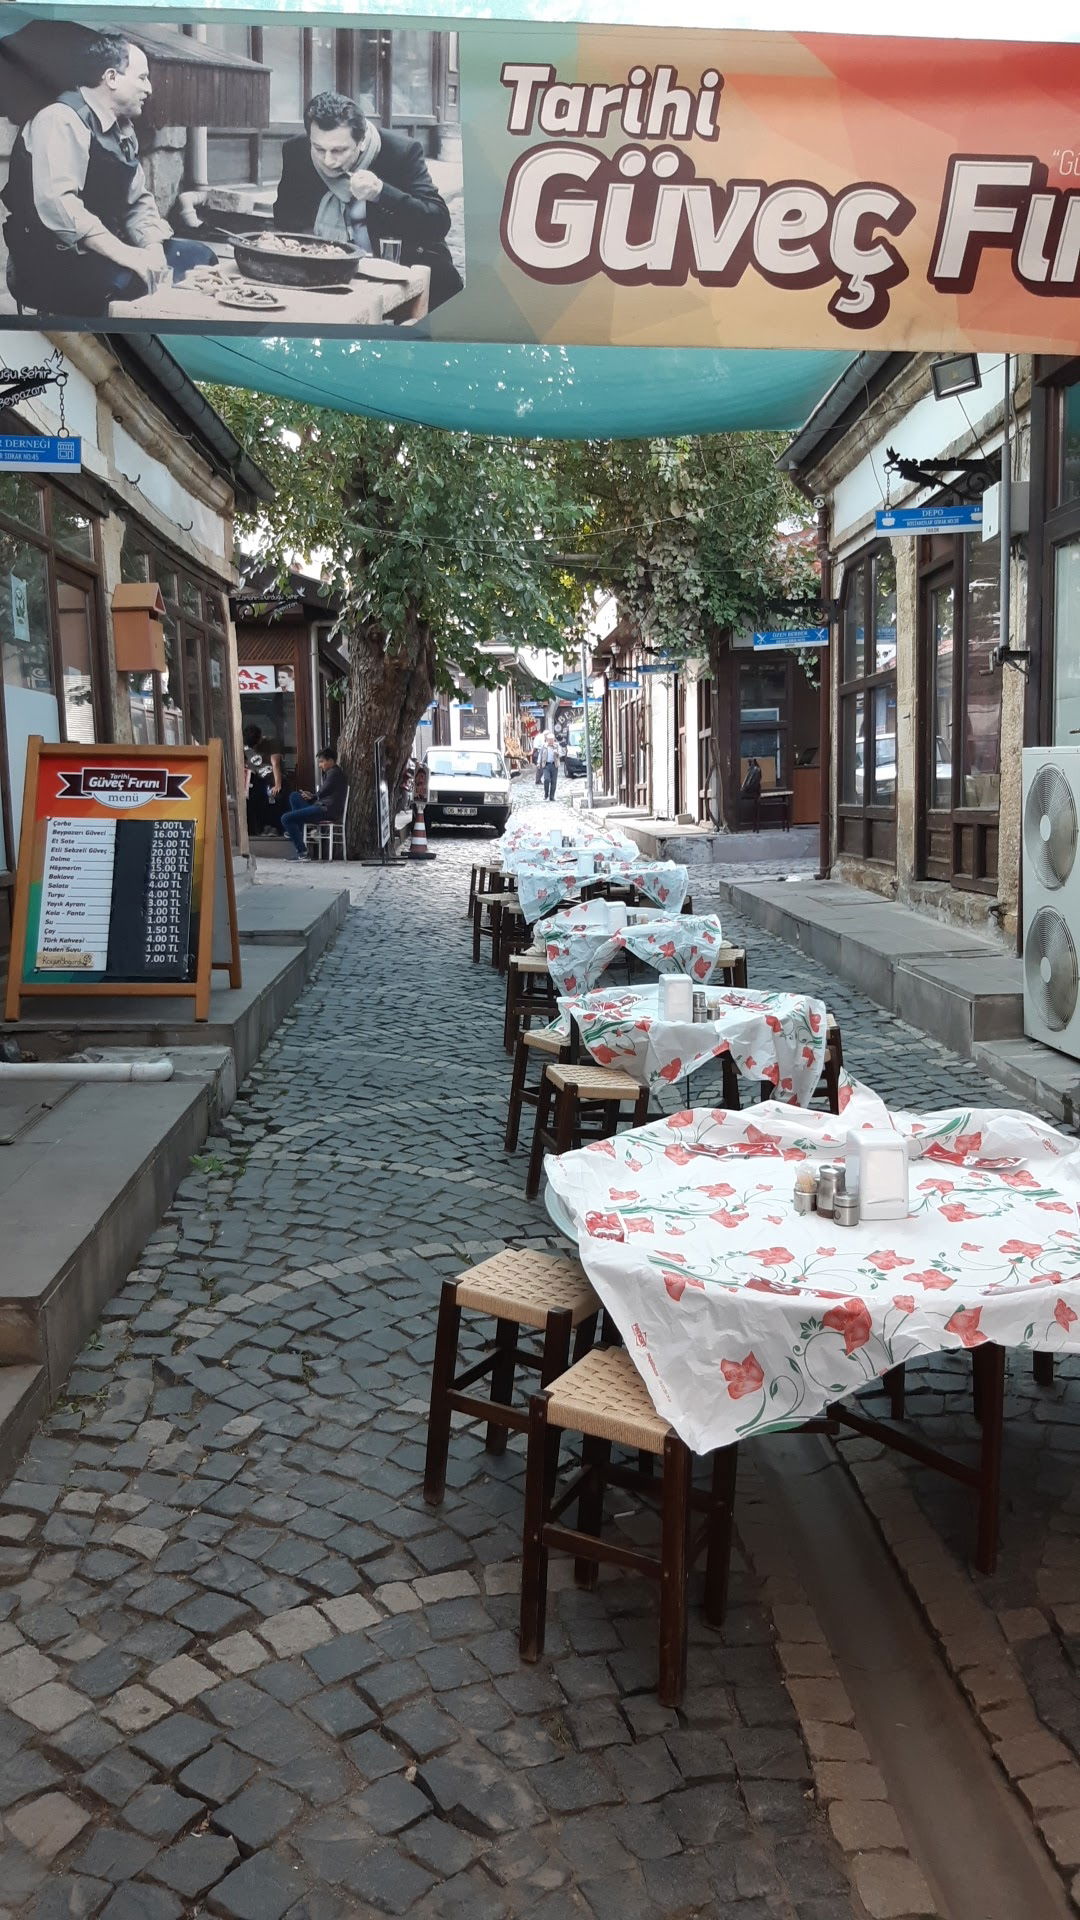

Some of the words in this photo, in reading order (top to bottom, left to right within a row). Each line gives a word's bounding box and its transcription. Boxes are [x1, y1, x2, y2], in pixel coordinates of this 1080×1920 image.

[502, 63, 723, 140] Tarihi
[503, 144, 910, 324] Güveç
[20, 366, 51, 381] Şehir
[5, 438, 51, 449] DERNEĞİ
[922, 509, 944, 517] DEPO
[88, 777, 126, 791] Güveç
[128, 778, 160, 789] Fırını
[108, 793, 139, 802] menü
[53, 820, 72, 828] Çorba
[154, 821, 184, 830] 5.00TL
[153, 830, 179, 838] 16.00
[181, 830, 192, 839] TL
[152, 840, 178, 848] 25.00
[180, 840, 190, 848] TL
[179, 849, 190, 857] TL
[178, 857, 189, 865] TL
[178, 865, 189, 873] TL
[148, 890, 168, 898] 4.00
[171, 890, 182, 898] TL
[148, 899, 168, 907] 3.00
[170, 899, 181, 907] TL
[147, 907, 168, 915] 3.00
[170, 907, 181, 915] TL
[147, 916, 168, 924] 1.00
[147, 926, 168, 934] 1.50
[169, 926, 180, 934] TL
[146, 935, 167, 943] 4.00
[169, 935, 180, 943] TL
[146, 944, 166, 952] 1.00
[168, 944, 179, 952] TL
[145, 954, 165, 963] 7.00
[167, 954, 178, 963] TL
